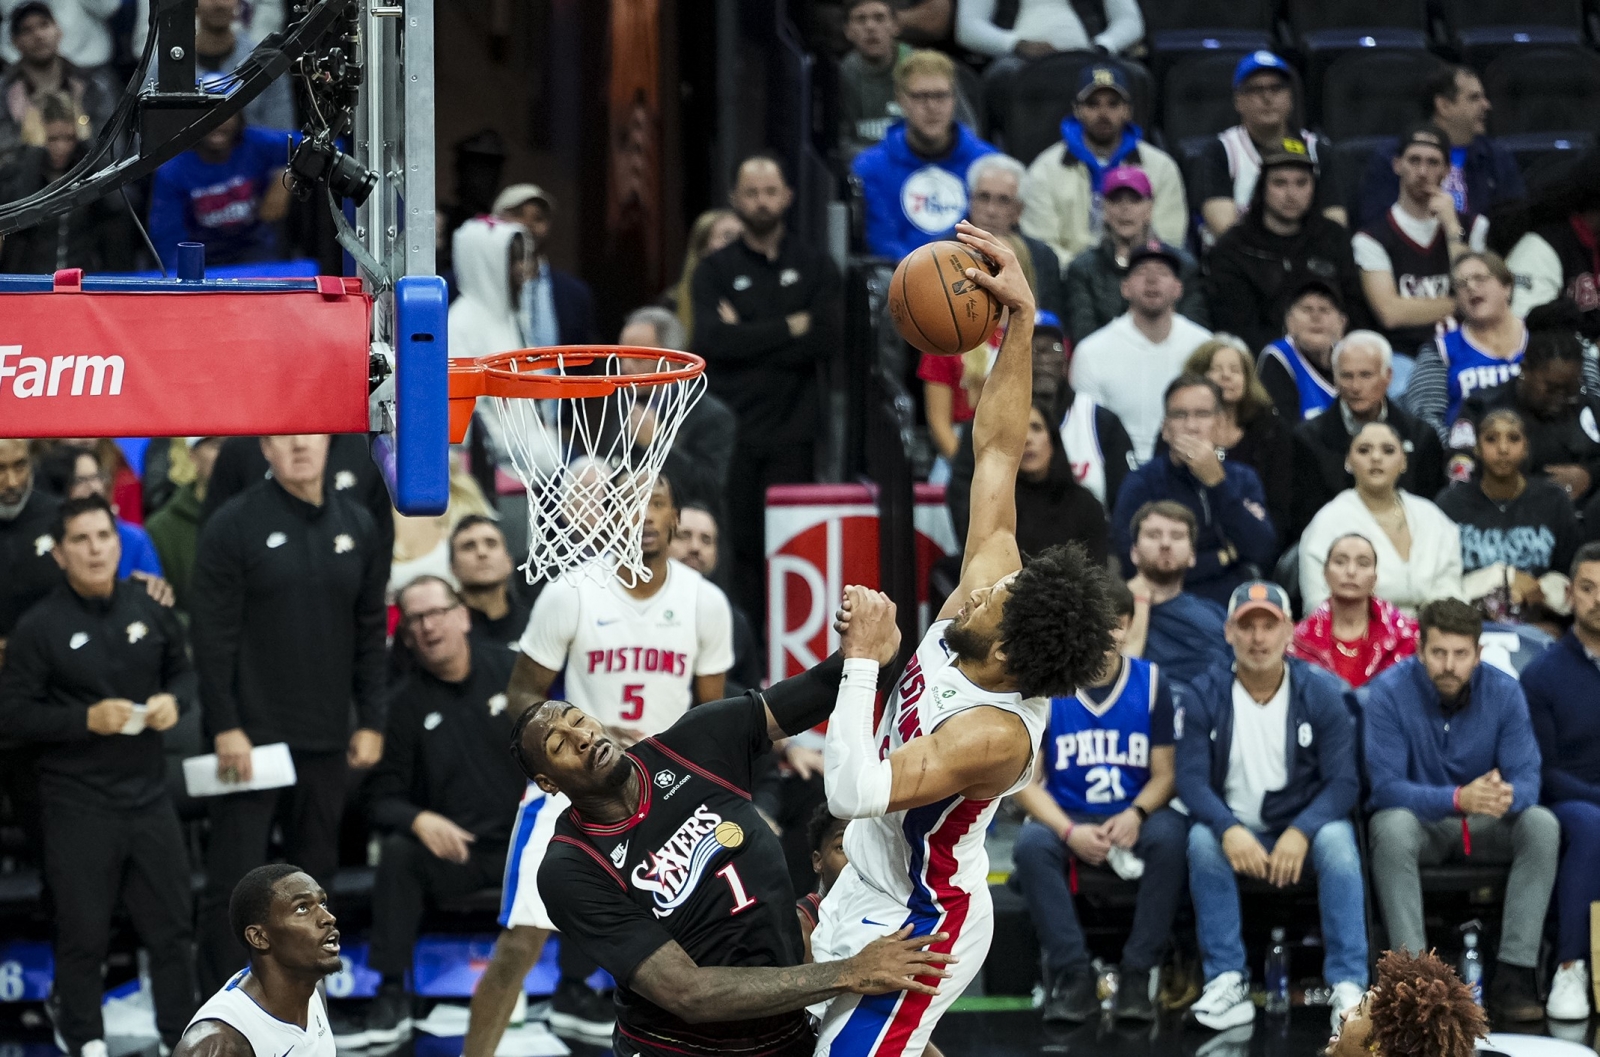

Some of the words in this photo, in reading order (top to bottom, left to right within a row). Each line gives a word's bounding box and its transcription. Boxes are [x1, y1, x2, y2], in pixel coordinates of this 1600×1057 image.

[0, 345, 125, 398] Farm
[587, 647, 688, 677] PISTONS
[620, 684, 645, 721] 5
[931, 685, 945, 711] StockX
[1055, 728, 1149, 771] PHILA
[663, 774, 692, 800] crypto.com
[1085, 766, 1127, 804] 21
[609, 842, 625, 863] NIKE
[715, 861, 757, 916] 1
